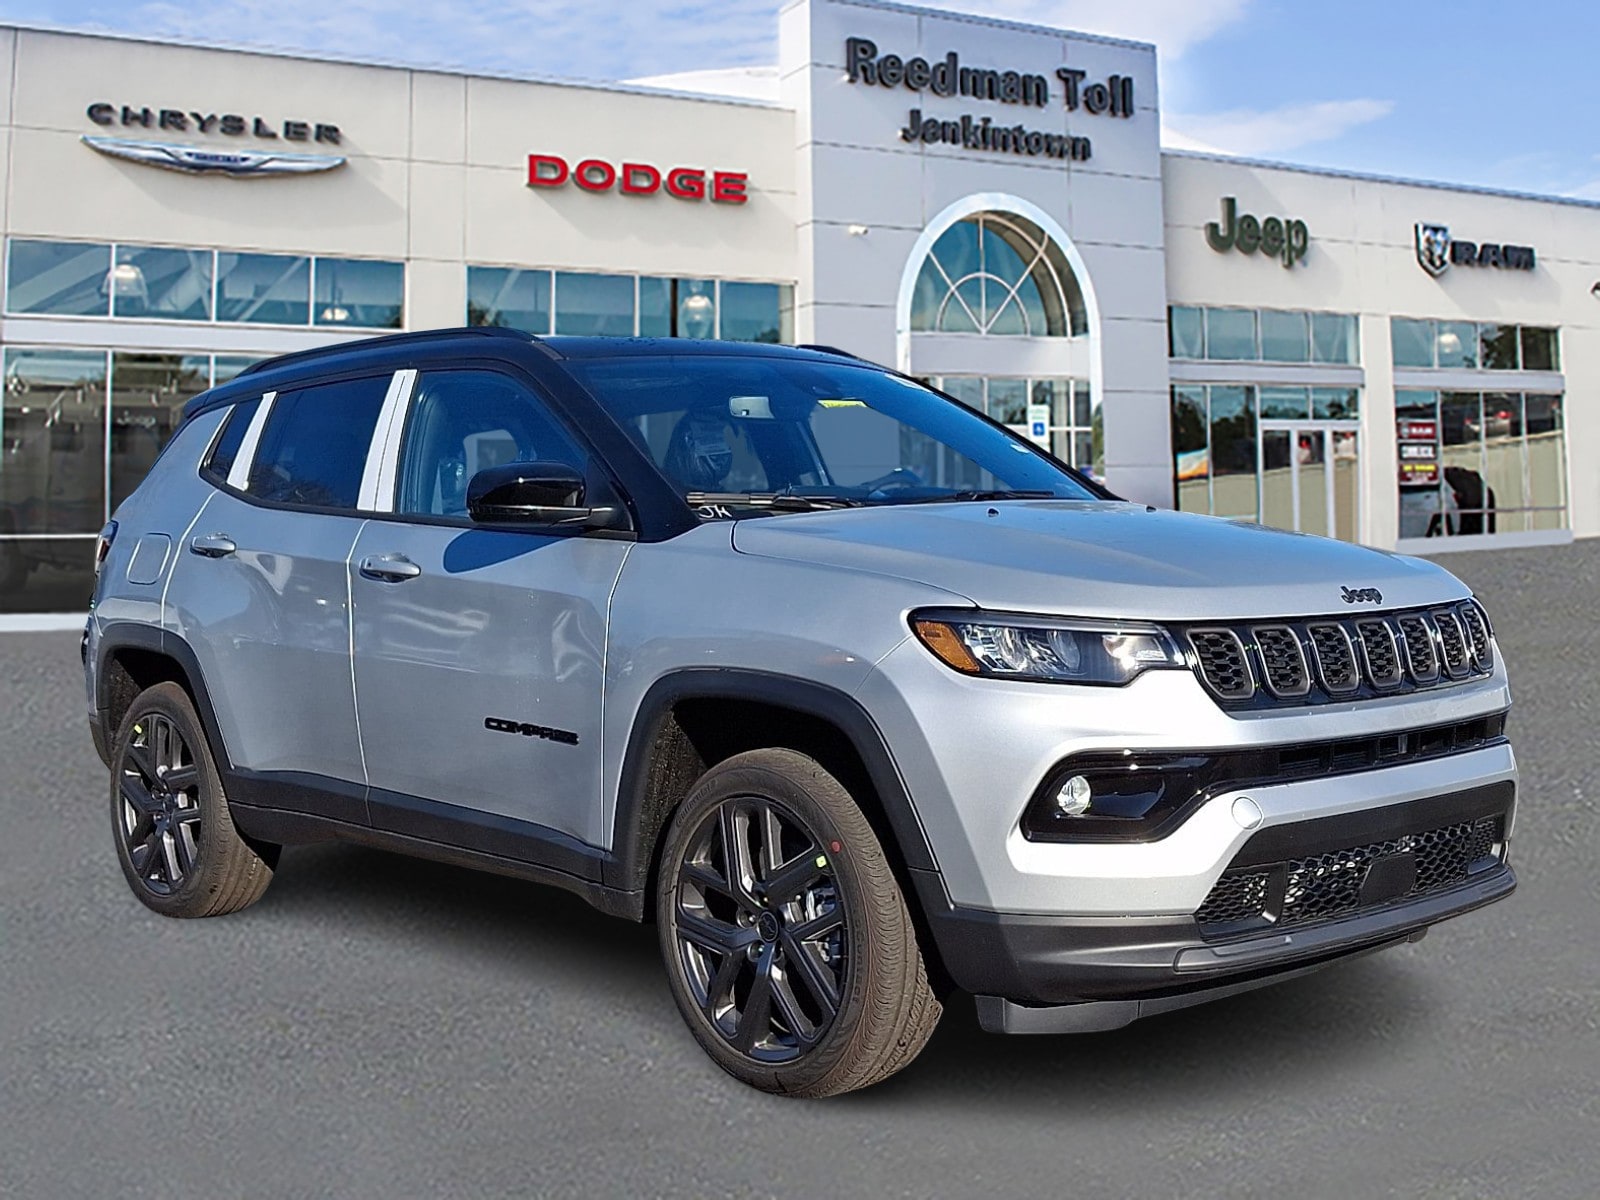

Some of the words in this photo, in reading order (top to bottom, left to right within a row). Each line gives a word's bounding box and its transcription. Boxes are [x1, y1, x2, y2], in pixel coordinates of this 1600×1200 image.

[846, 37, 1048, 107] Reedman
[1056, 67, 1134, 118] Toll
[87, 103, 341, 145] CHRYSLER
[902, 109, 1092, 161] Jenkintown
[527, 154, 748, 204] DODGE
[1204, 197, 1308, 269] Jeep
[1451, 240, 1536, 271] RAM
[1340, 585, 1383, 605] Jeep
